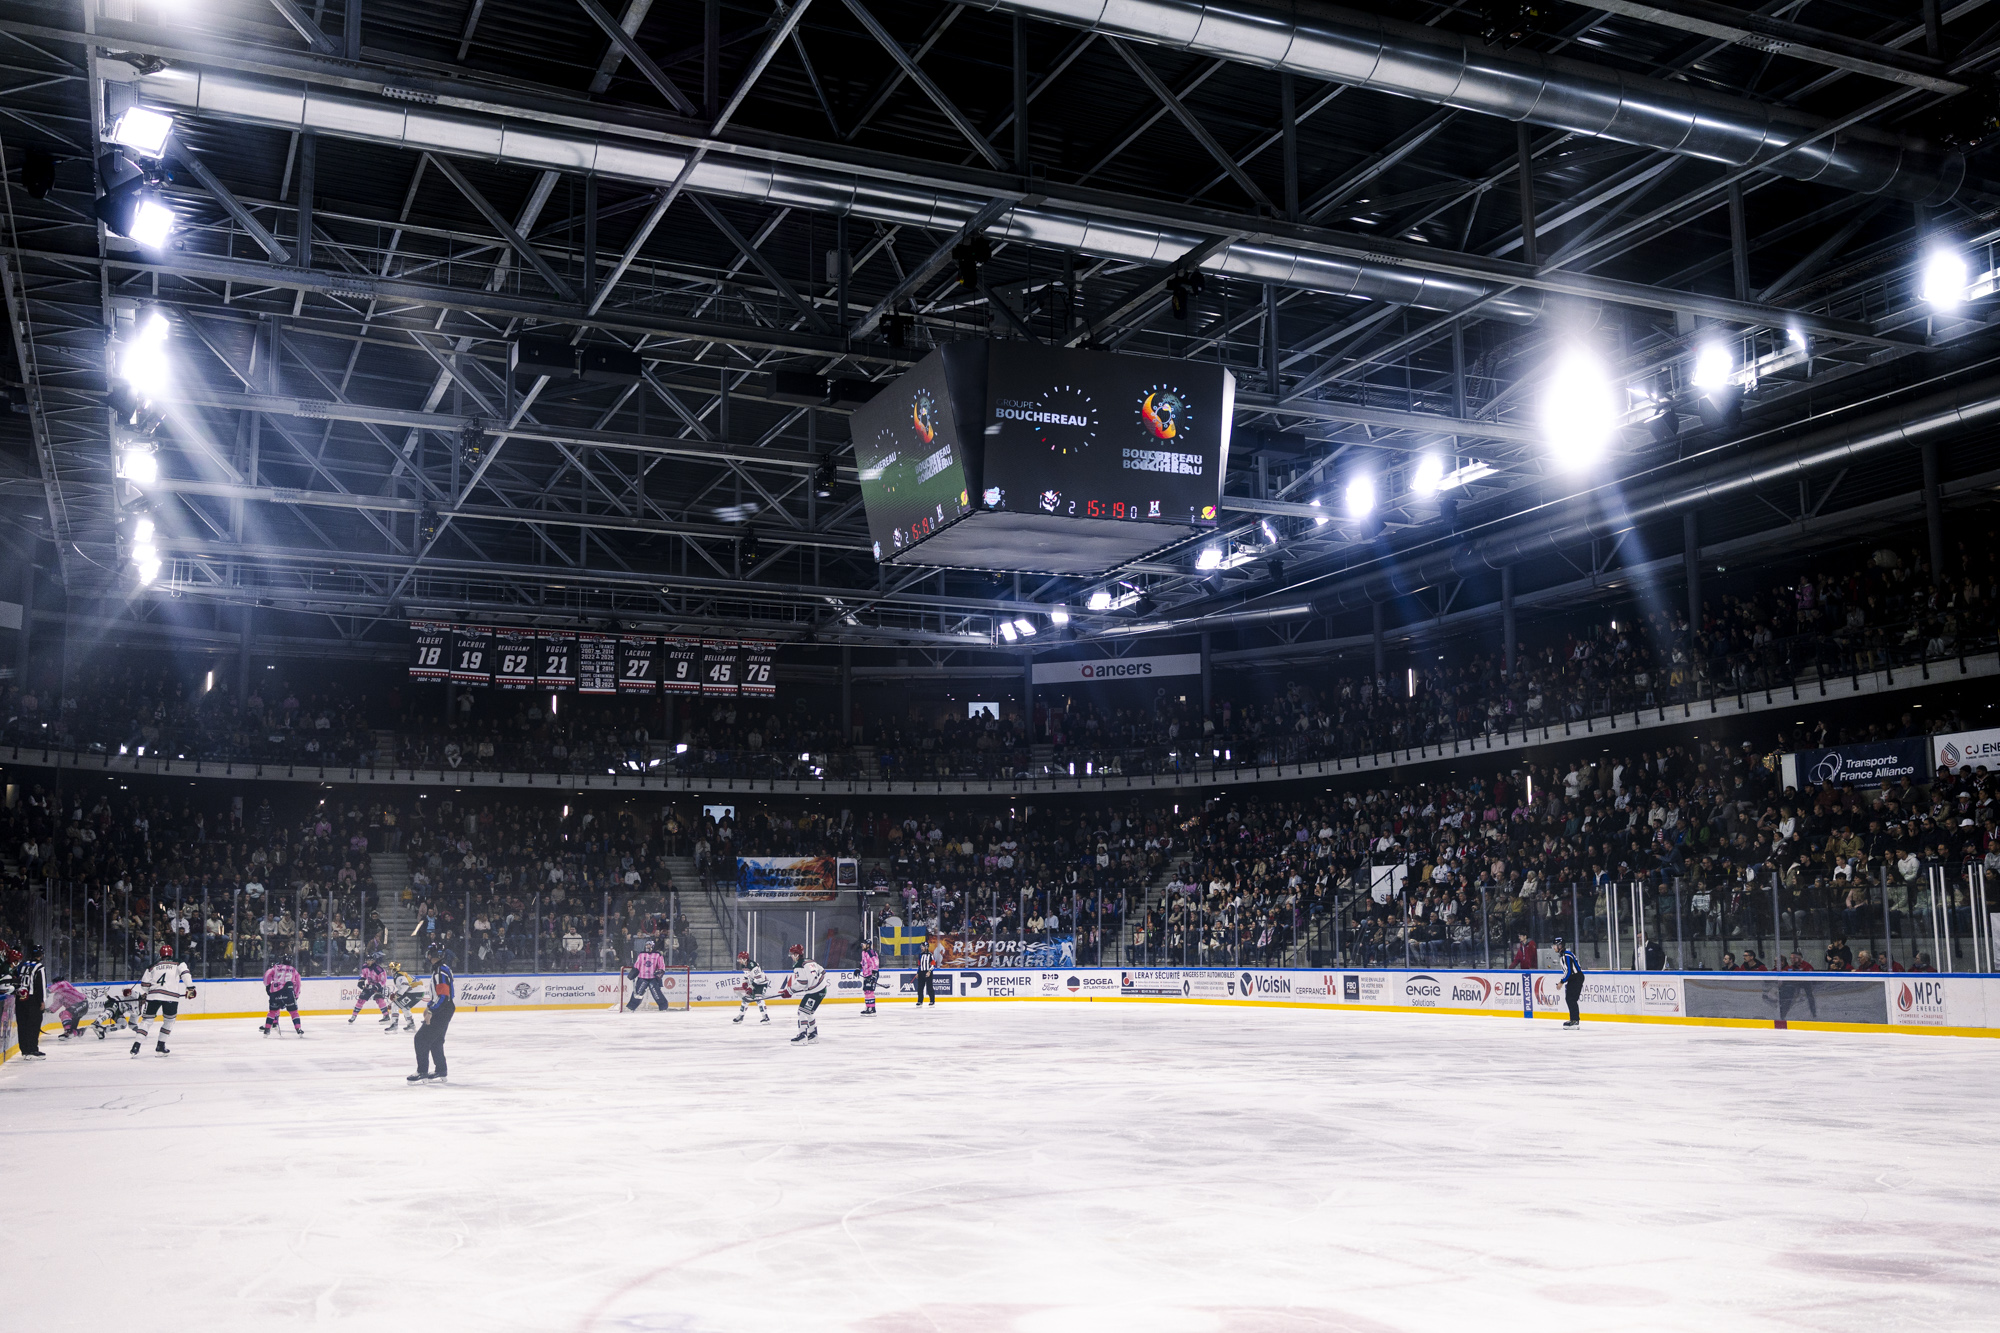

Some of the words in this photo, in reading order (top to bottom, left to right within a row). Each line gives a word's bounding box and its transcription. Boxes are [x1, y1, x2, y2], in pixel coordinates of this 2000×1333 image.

[996, 398, 1034, 409] GROUPE
[995, 408, 1087, 427] BOUCHEREAU
[1068, 501, 1076, 514] 2
[1130, 506, 1137, 519] 0
[417, 637, 443, 645] ALBERT
[458, 640, 486, 648] LACROIX
[546, 646, 568, 654] VOGIN
[625, 650, 651, 658] LACROIX
[418, 647, 441, 666] 18
[460, 651, 482, 669] 19
[502, 654, 528, 673] 62
[546, 656, 568, 674] 21
[626, 660, 650, 678] 27
[676, 662, 688, 678] 9
[710, 664, 731, 681] 45
[747, 664, 770, 681] 76
[1096, 662, 1152, 678] angers
[1965, 744, 1979, 755] CJ
[1846, 754, 1898, 769] Transports
[1840, 770, 1873, 781] France
[1874, 766, 1914, 778] Alliance
[753, 868, 802, 877] RAPTORS
[953, 940, 1028, 952] RAPTORS
[978, 955, 1054, 967] D'ANGERS
[156, 972, 166, 986] 4
[715, 978, 740, 990] FRITES
[987, 976, 1031, 986] PREMIER
[461, 982, 473, 991] Le
[474, 983, 497, 991] Petit
[900, 983, 915, 991] AXA
[987, 988, 1015, 996] TECH
[1042, 983, 1059, 992] Ford
[1504, 982, 1521, 996] EDL
[461, 992, 496, 1001] Manoir
[1452, 986, 1482, 1002] ARBM
[1579, 994, 1635, 1004] OFFICINALE.COM
[1914, 982, 1942, 1005] MPC
[1412, 999, 1435, 1007] Solutions
